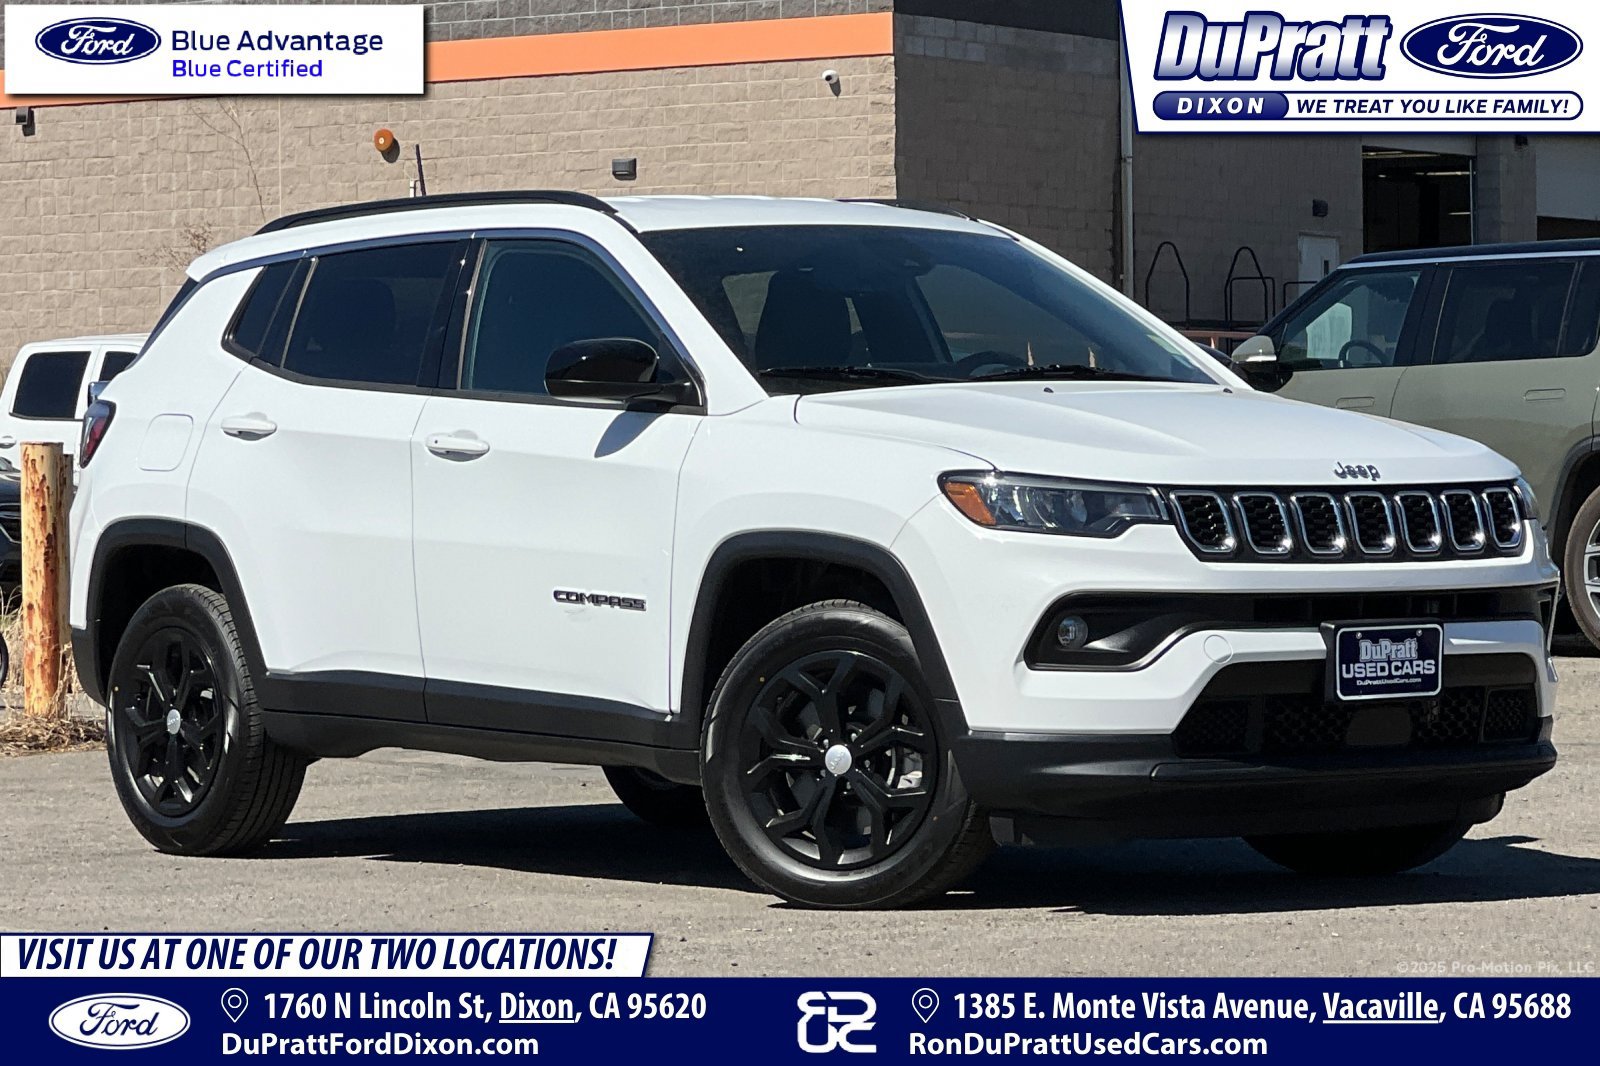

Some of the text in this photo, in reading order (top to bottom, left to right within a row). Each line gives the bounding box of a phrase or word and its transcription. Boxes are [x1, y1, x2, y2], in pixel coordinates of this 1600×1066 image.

[1334, 461, 1381, 482] Jeep
[553, 590, 647, 612] COMPASS
[1359, 638, 1418, 661] DuPratt
[1342, 659, 1435, 678] USED CARS
